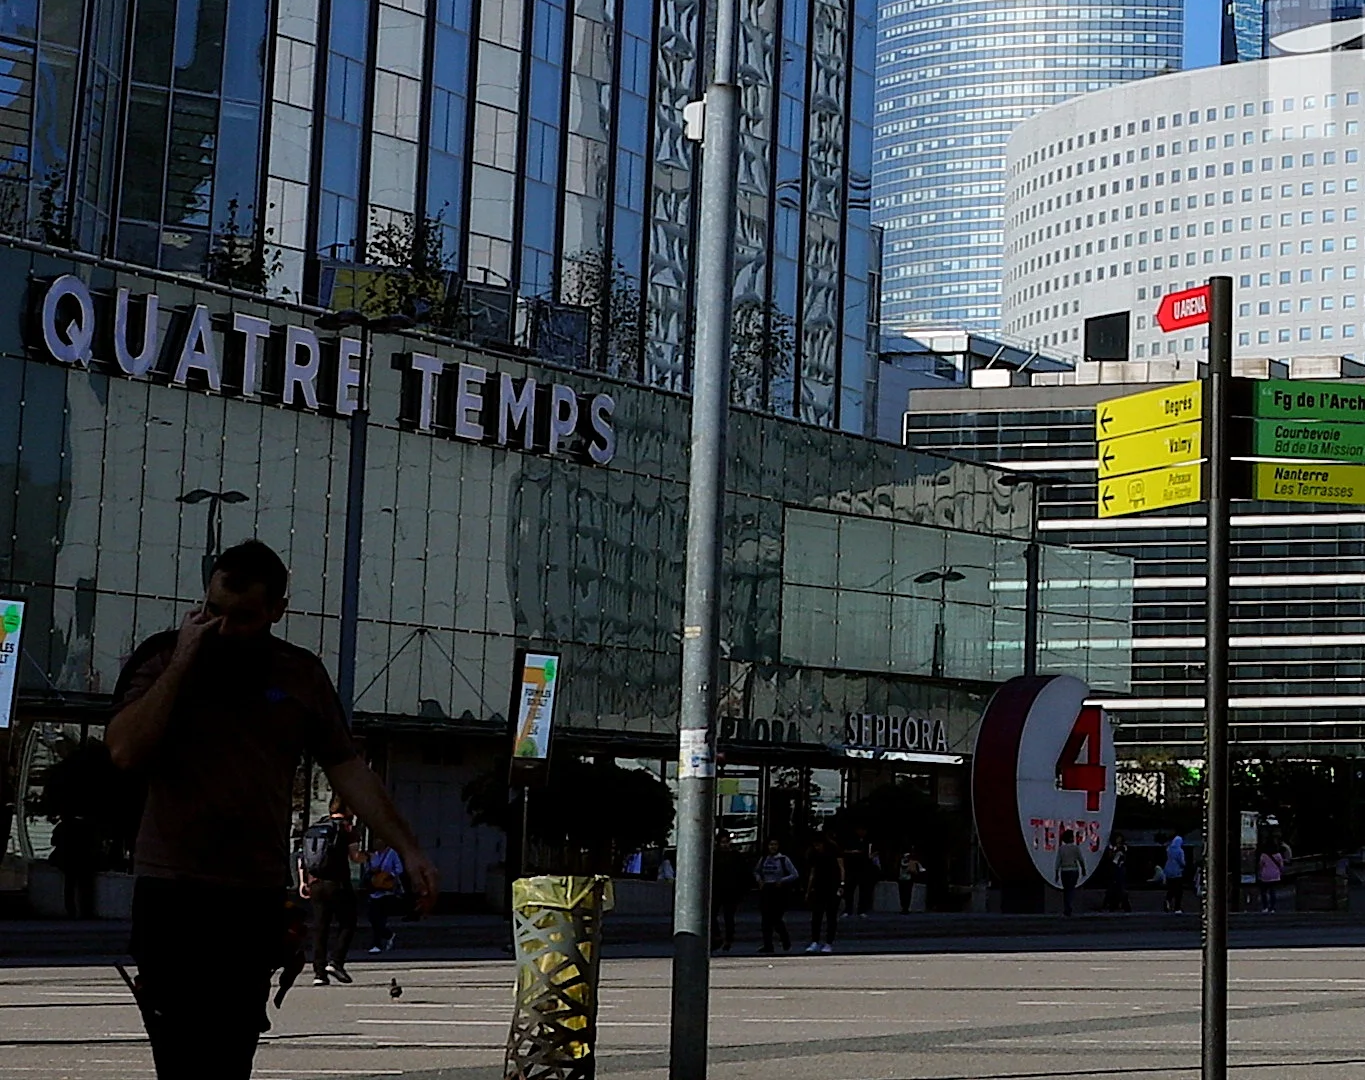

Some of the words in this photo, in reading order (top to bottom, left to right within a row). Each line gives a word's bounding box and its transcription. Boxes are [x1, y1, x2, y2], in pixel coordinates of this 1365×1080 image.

[42, 274, 369, 415] QUATRE
[411, 353, 617, 465] TEMPS
[1297, 392, 1314, 407] de
[1275, 426, 1341, 441] Courbevoie
[1275, 441, 1290, 453] Bd
[1292, 442, 1305, 454] de
[1308, 442, 1318, 454] la
[1321, 443, 1363, 456] Mission
[1274, 468, 1329, 481] Nanterre
[1274, 483, 1294, 495] Les
[1297, 483, 1354, 498] Terrasses
[0, 642, 15, 653] LES
[848, 711, 947, 752] SEPHORA
[1056, 704, 1106, 811] 4
